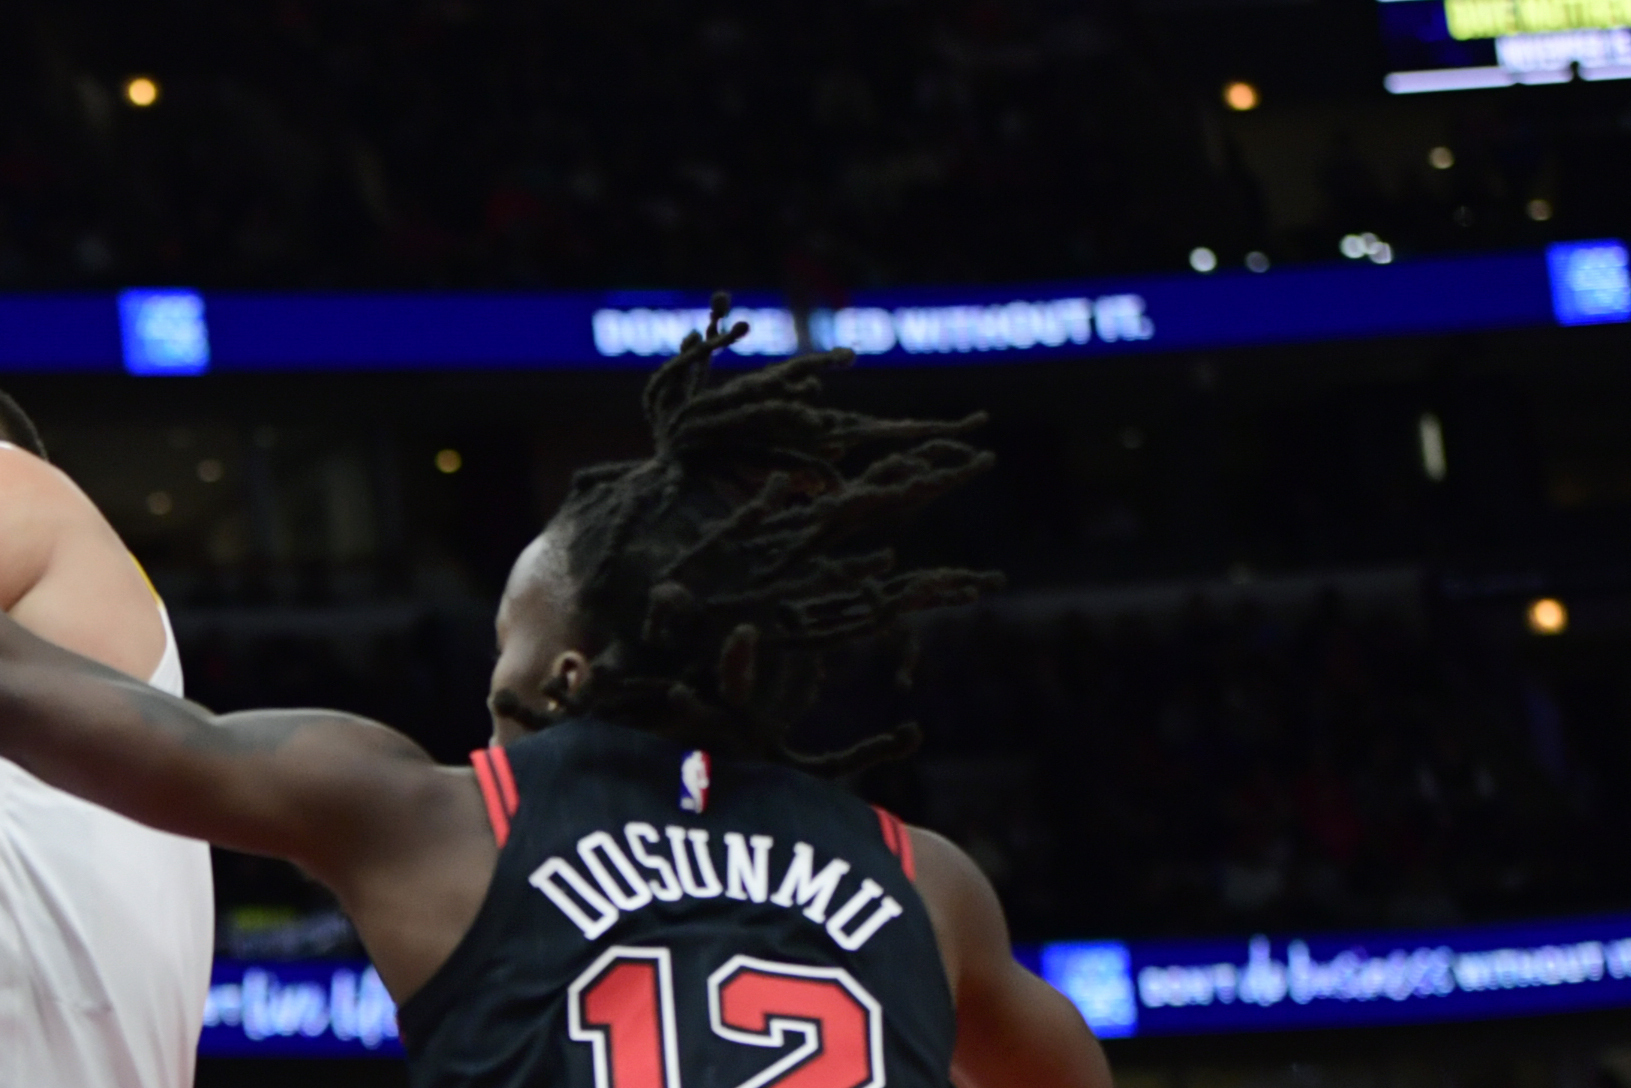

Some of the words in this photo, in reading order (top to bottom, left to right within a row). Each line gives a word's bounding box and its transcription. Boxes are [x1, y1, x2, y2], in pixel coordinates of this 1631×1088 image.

[892, 297, 1092, 354] WITHOUT
[529, 822, 902, 950] DOSUNMU
[1454, 940, 1605, 992] WITHOUT
